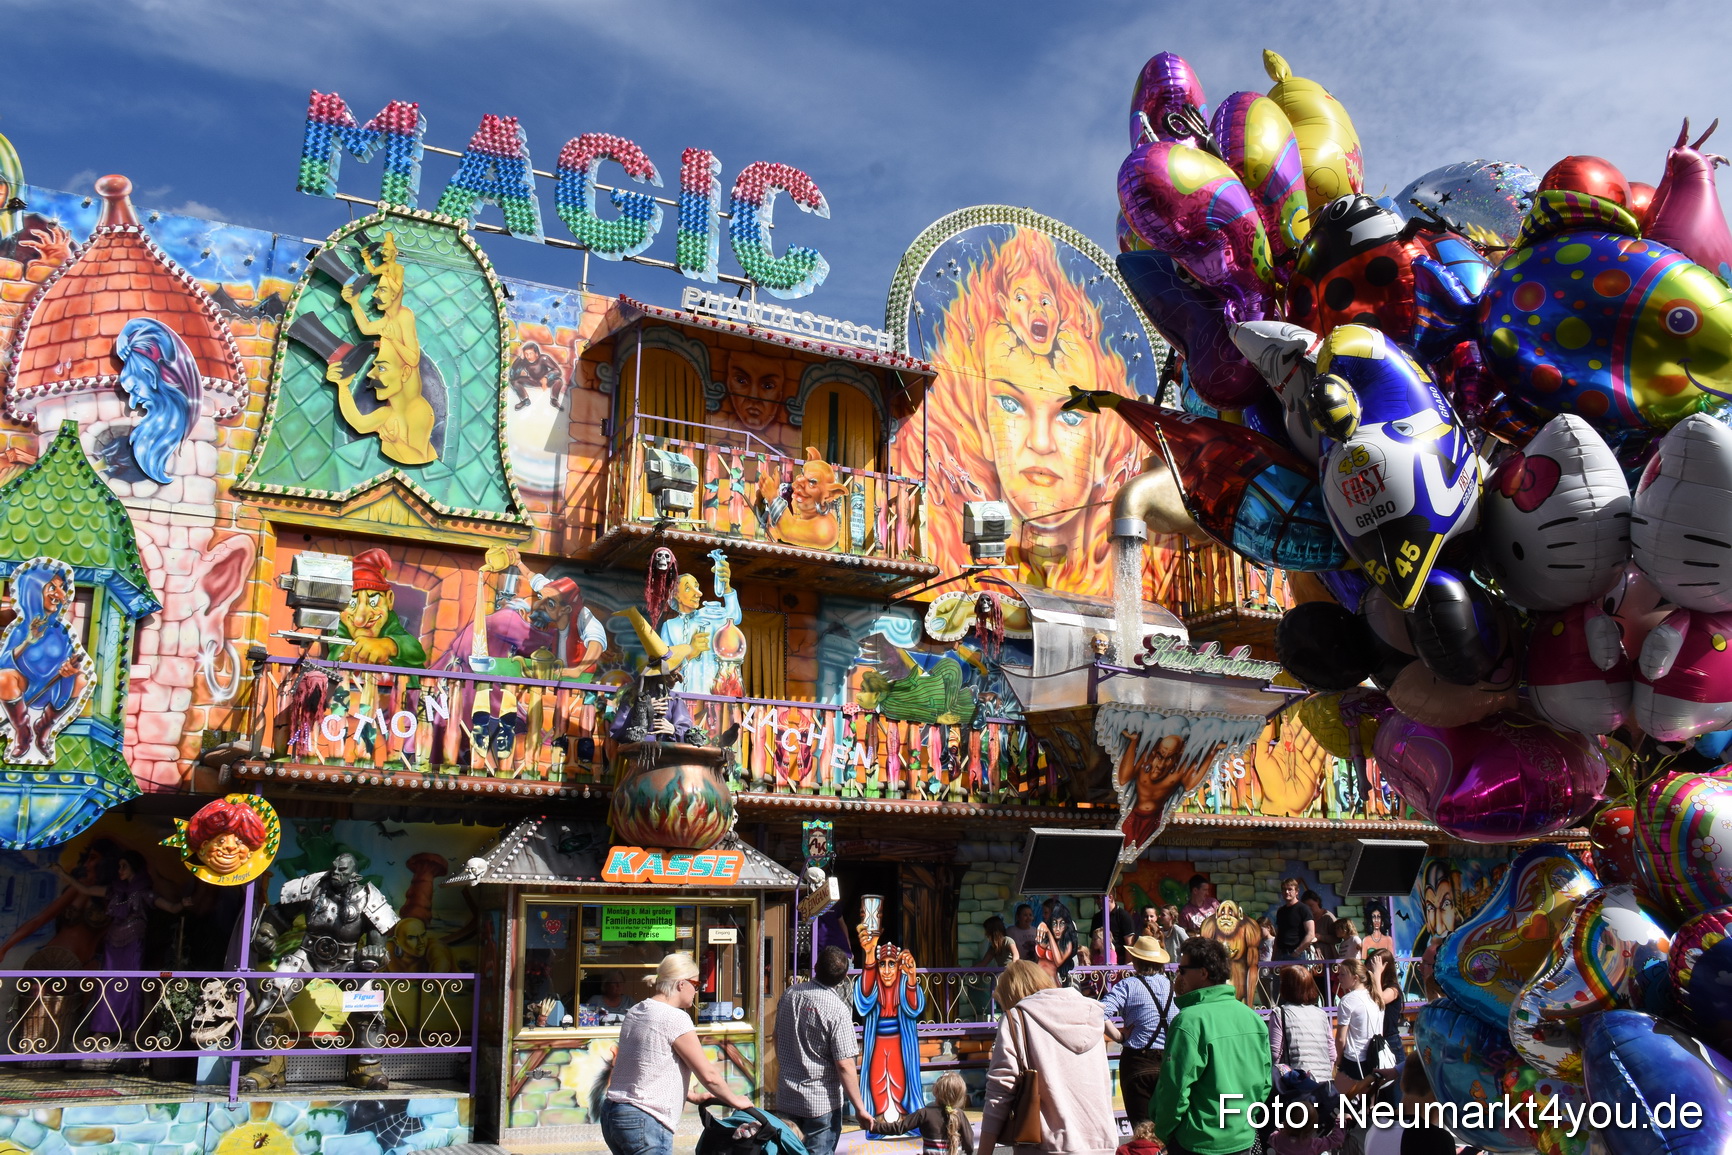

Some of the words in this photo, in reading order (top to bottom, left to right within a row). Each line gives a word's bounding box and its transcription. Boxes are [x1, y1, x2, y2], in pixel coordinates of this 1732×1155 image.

[298, 89, 830, 299] MAGIC
[681, 286, 894, 351] PHANTASTISCH
[1429, 386, 1450, 418] GRABO
[1338, 444, 1370, 475] 45
[1341, 463, 1386, 508] FAST
[1355, 500, 1397, 529] GRABO
[1364, 558, 1390, 586] 45
[1394, 539, 1421, 579] 45
[741, 705, 873, 770] LACHEN
[607, 851, 739, 878] KASSE
[605, 916, 673, 926] Familienachmittag
[606, 908, 630, 916] Montag
[652, 908, 672, 916] großer
[353, 993, 375, 1001] Figur
